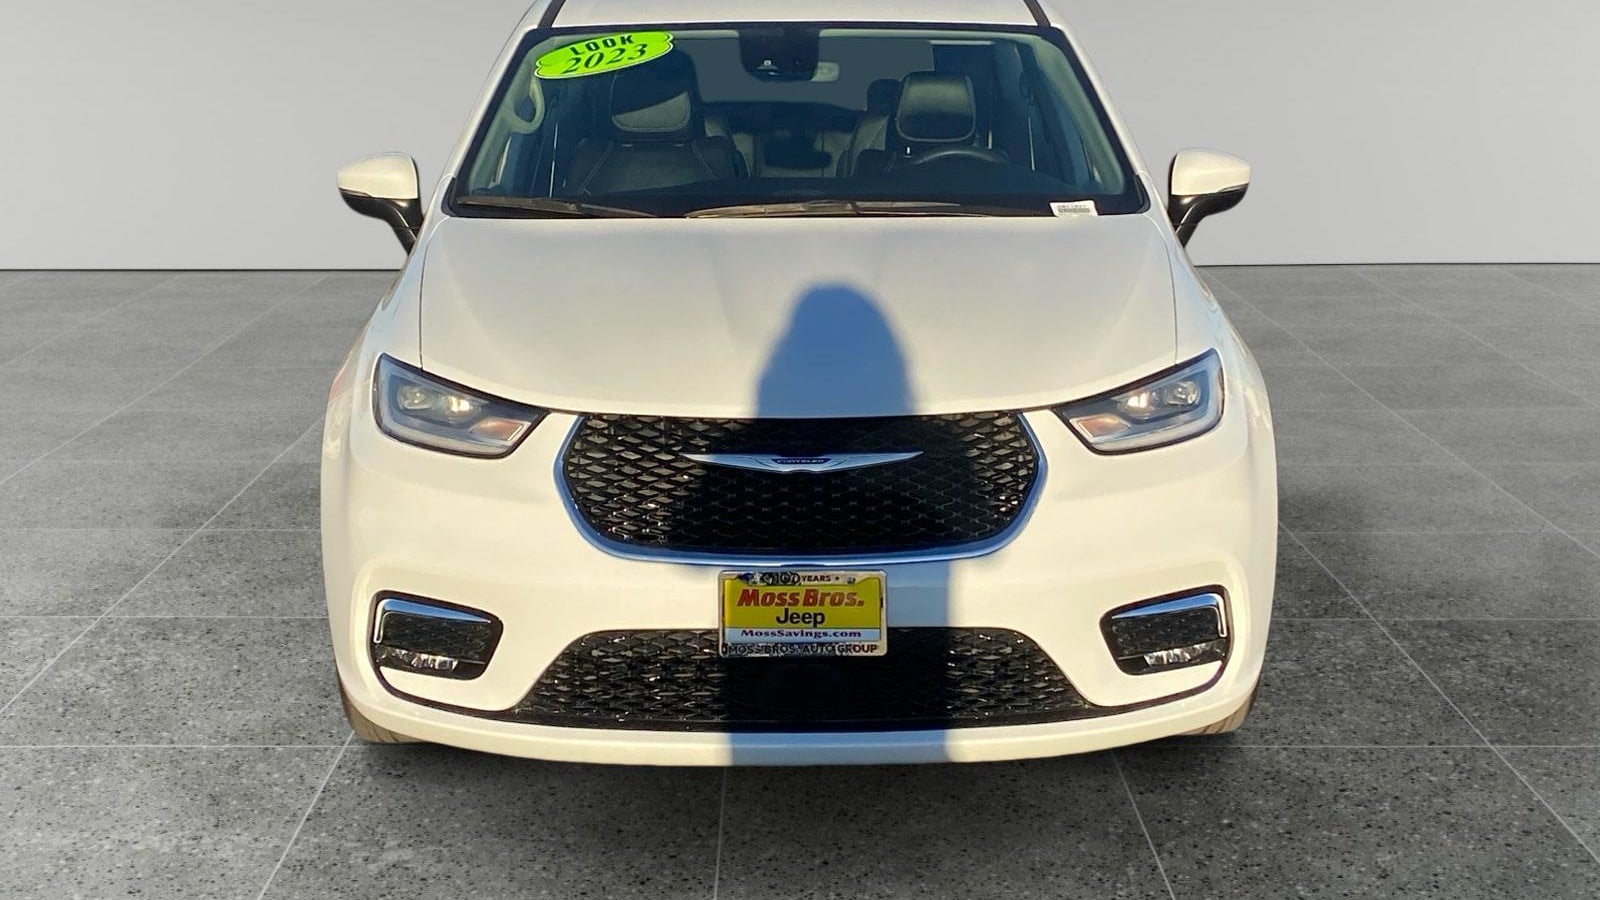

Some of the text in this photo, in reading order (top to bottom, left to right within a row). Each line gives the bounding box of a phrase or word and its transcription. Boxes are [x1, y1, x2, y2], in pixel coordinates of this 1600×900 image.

[570, 35, 634, 55] LOOK
[561, 43, 648, 74] 2023
[801, 575, 831, 583] YEARS
[737, 589, 864, 607] Moss Bros.
[775, 608, 826, 628] Jeep
[740, 629, 862, 639] MossSavings.com
[728, 645, 762, 655] MOSS
[803, 644, 834, 654] AUTO
[836, 644, 879, 654] GROUP
